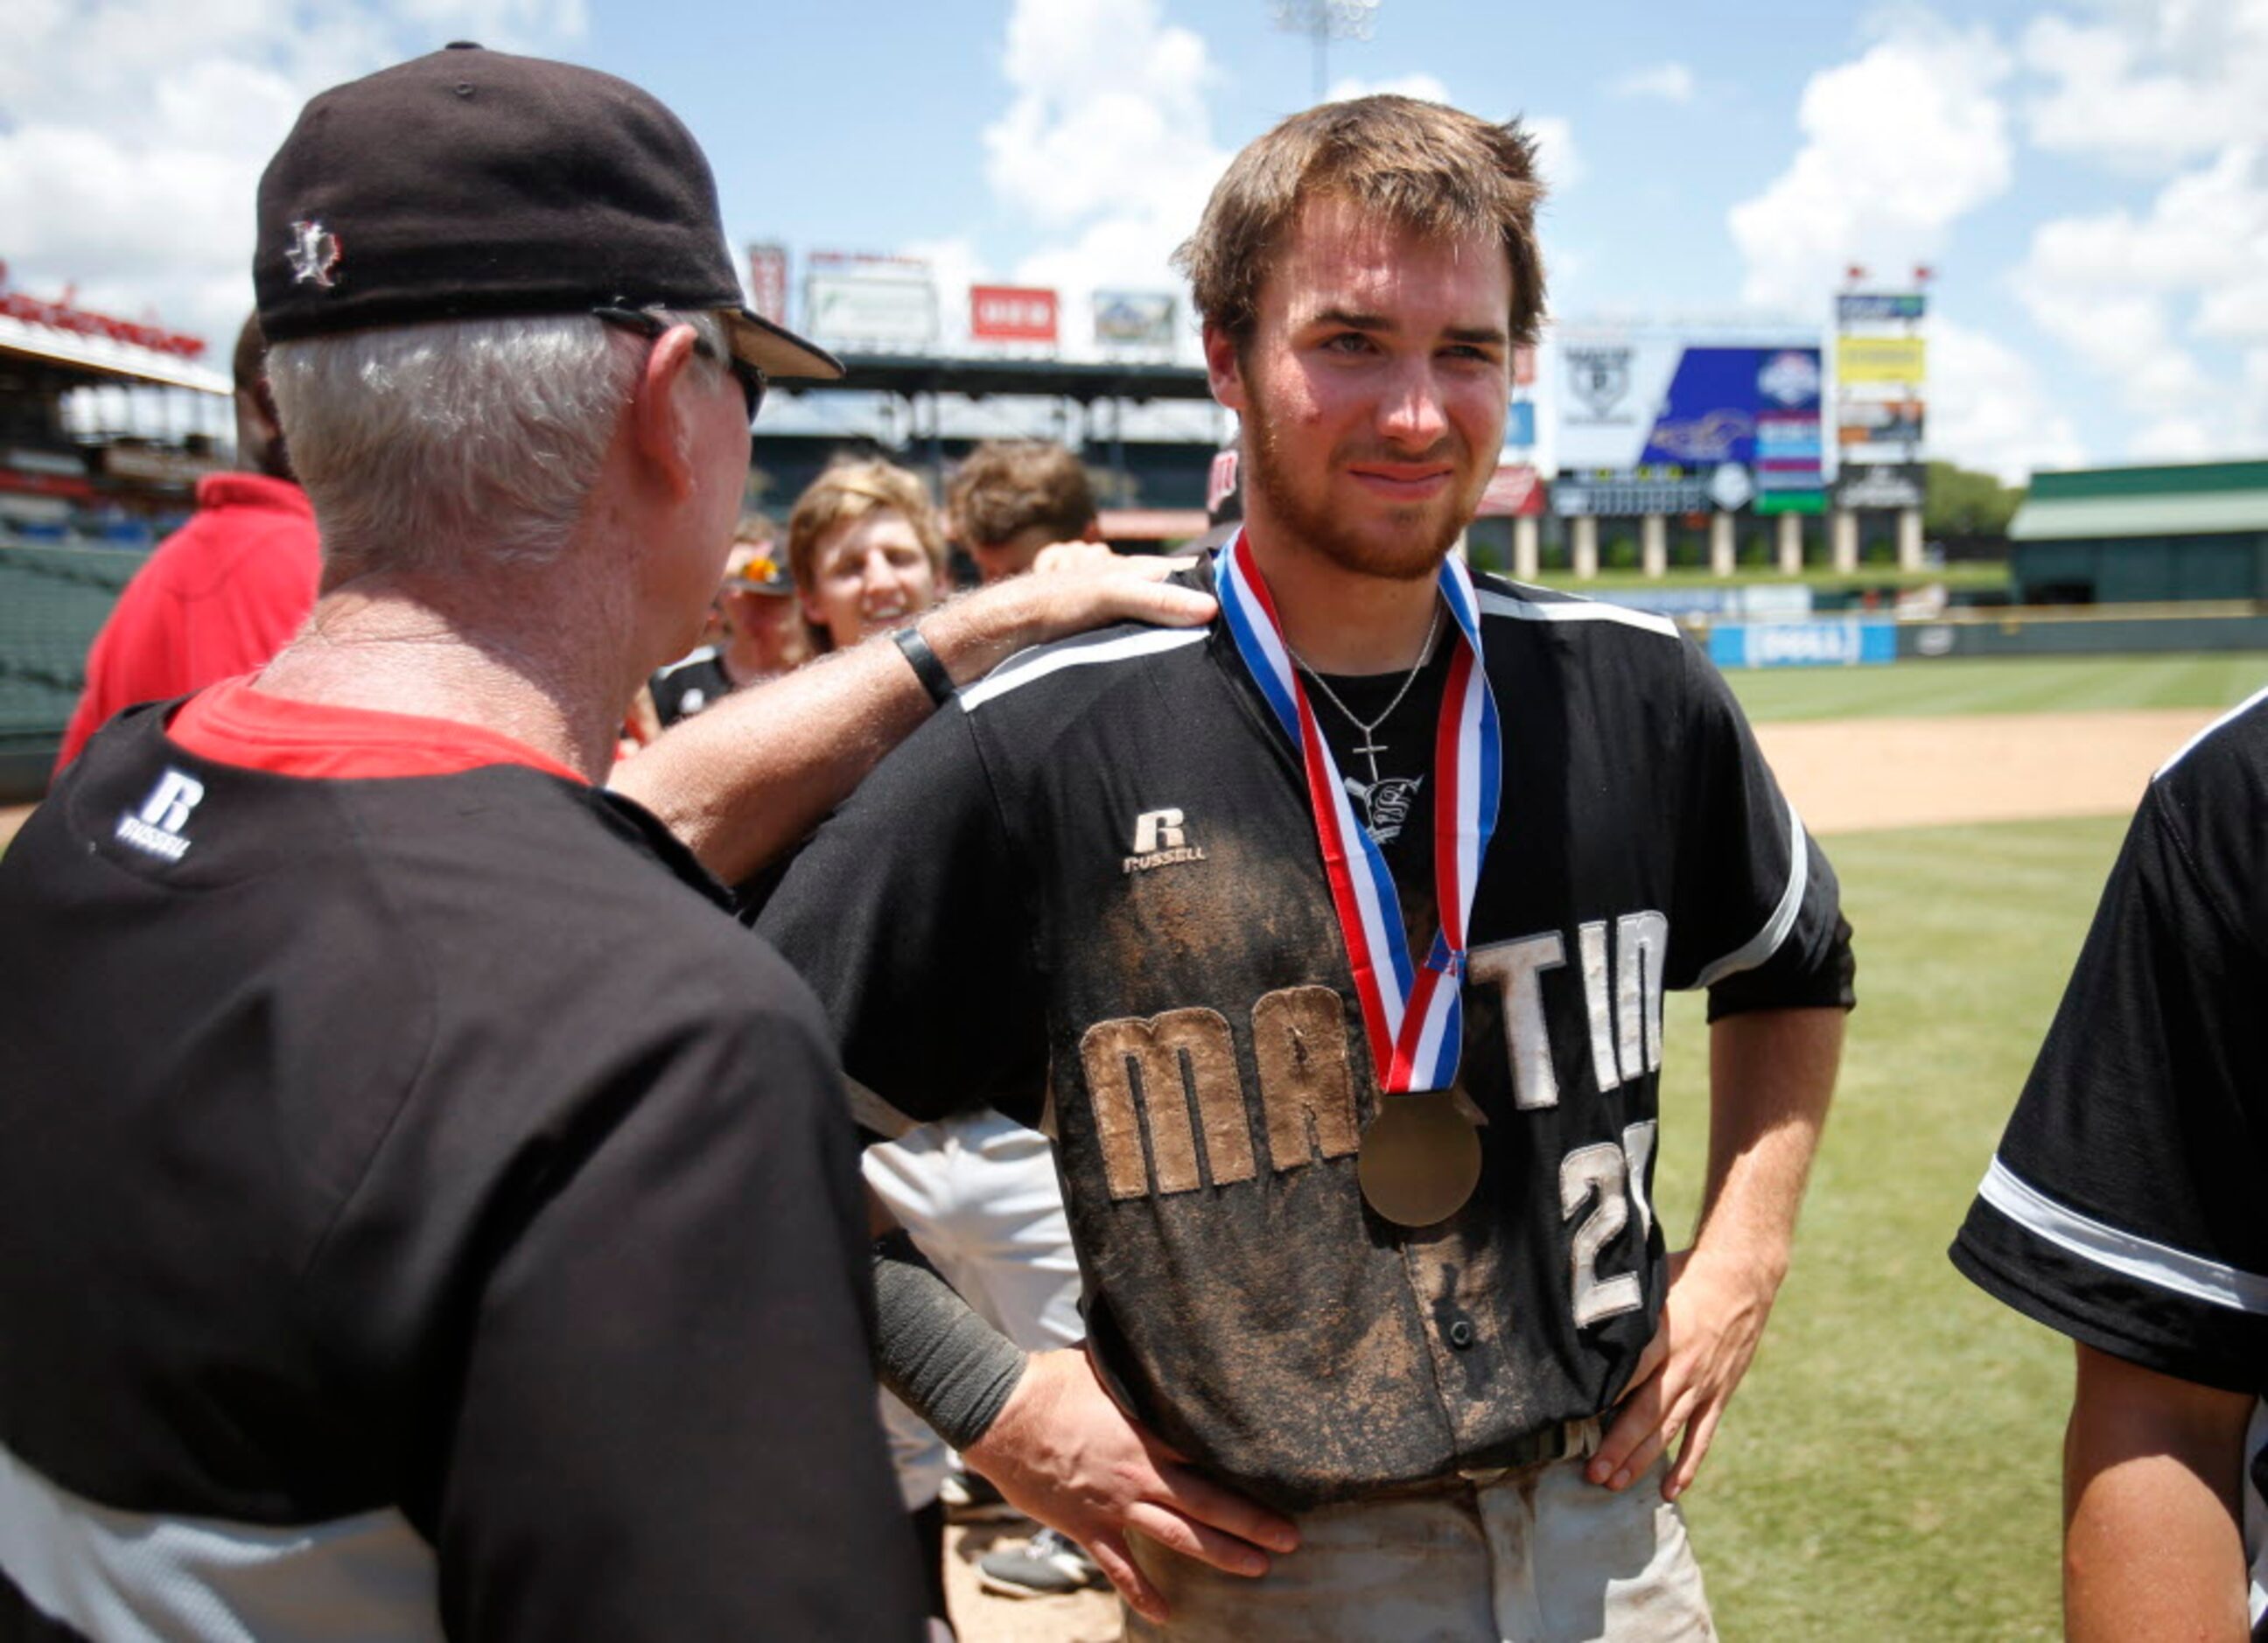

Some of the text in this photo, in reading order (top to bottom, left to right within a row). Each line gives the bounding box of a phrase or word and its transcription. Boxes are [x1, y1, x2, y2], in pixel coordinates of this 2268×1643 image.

[140, 770, 204, 835] R
[1134, 808, 1185, 854] R
[1123, 847, 1207, 873] RUSSELL
[1078, 910, 1668, 1201] MATIN
